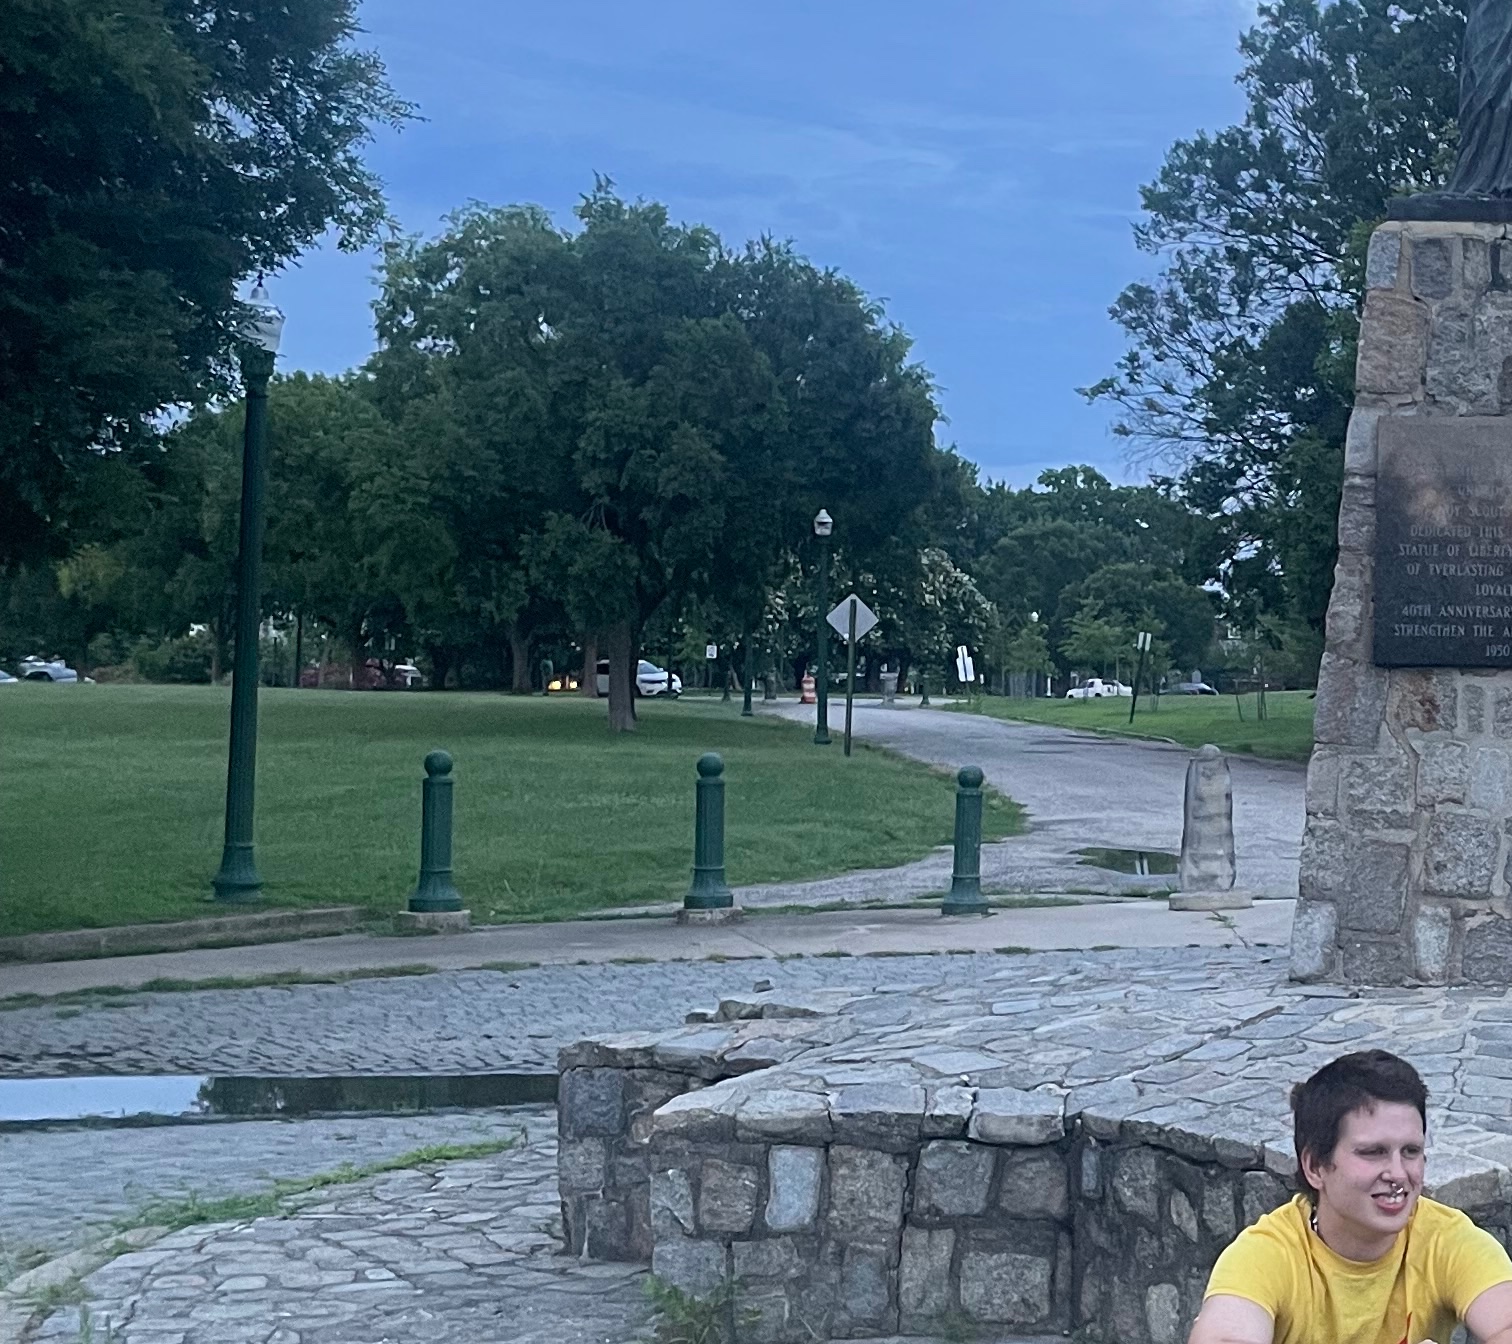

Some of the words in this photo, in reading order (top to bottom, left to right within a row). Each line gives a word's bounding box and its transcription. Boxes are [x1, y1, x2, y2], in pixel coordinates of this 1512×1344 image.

[1410, 524, 1472, 538] DEDICATED
[1399, 543, 1440, 557] STATUE
[1446, 544, 1460, 557] OF
[1406, 562, 1421, 576] OF
[1428, 563, 1504, 577] EVERLASTING
[1402, 604, 1432, 617] 40TH
[1394, 623, 1466, 637] STRENGTHEN
[1472, 624, 1494, 637] THE
[1485, 643, 1511, 657] 1950
